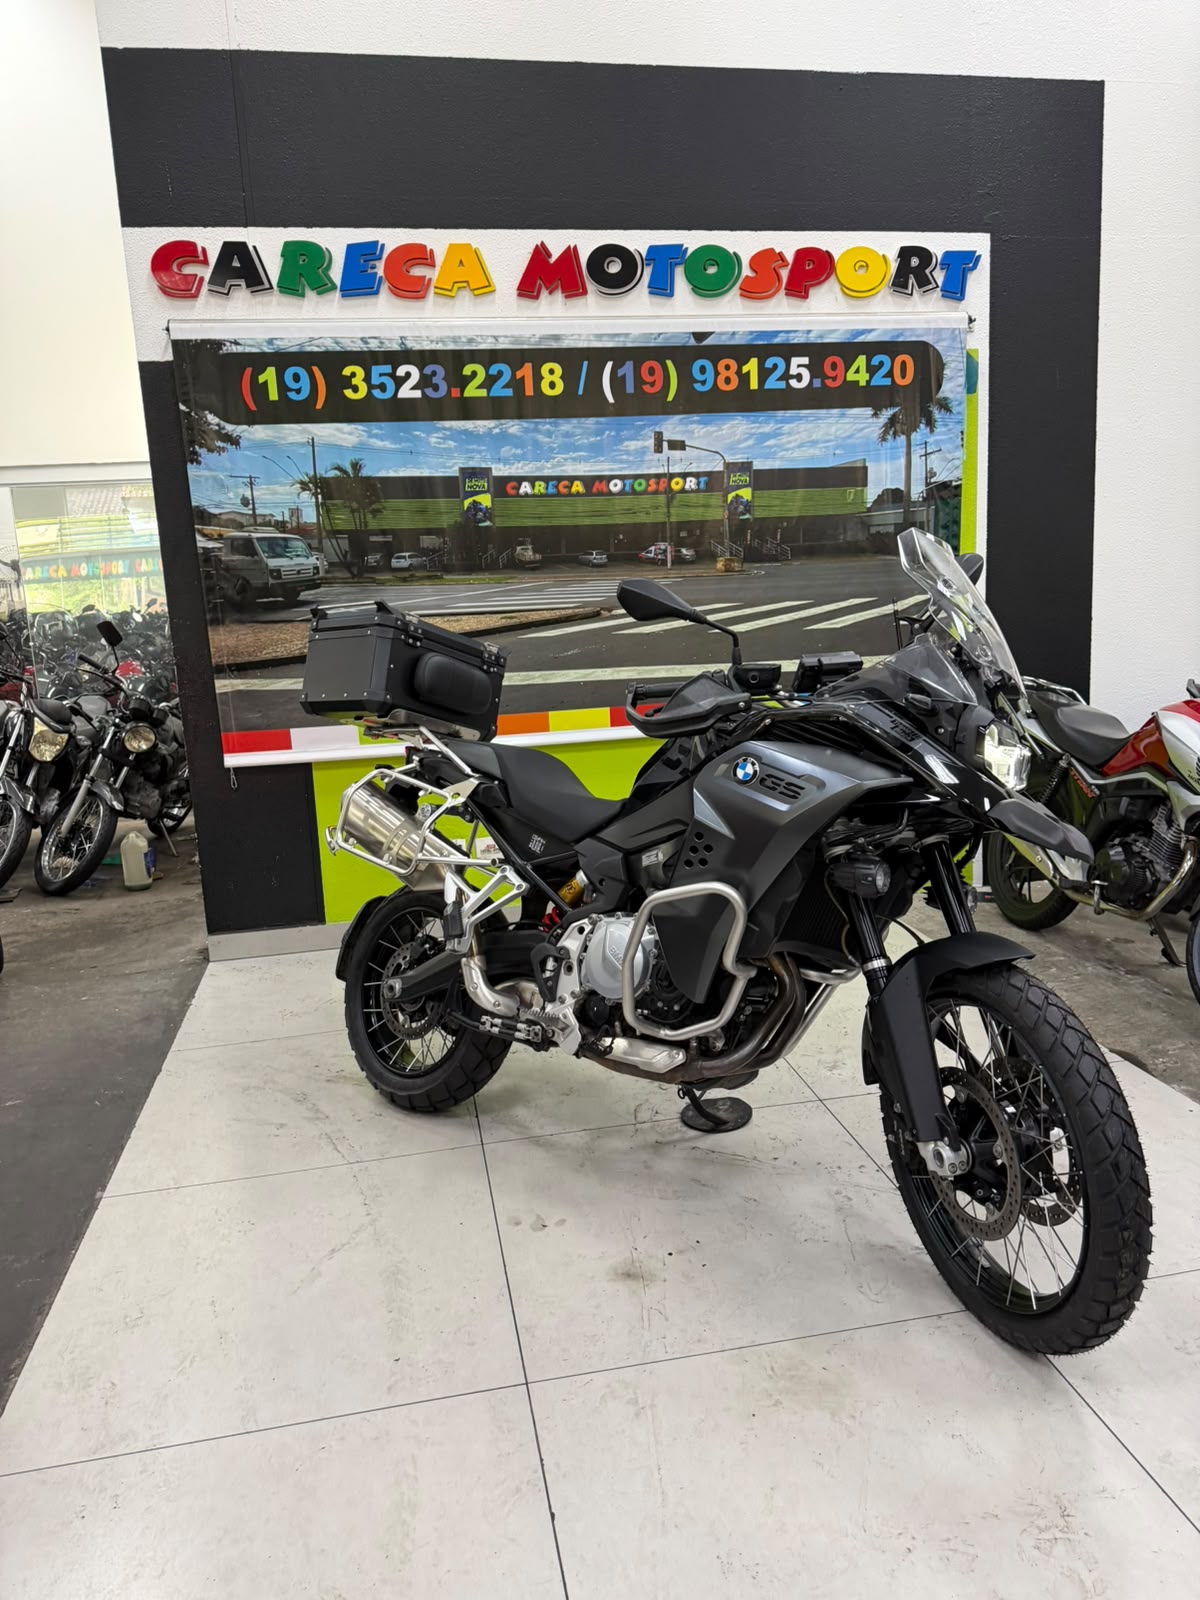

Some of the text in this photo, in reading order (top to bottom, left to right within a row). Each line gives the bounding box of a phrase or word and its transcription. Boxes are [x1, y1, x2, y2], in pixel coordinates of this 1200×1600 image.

[150, 239, 982, 301] CARECA MOTOSPORT
[240, 366, 327, 411] (19)
[341, 362, 564, 400] 3523.2218
[602, 359, 678, 403] (19)
[691, 354, 914, 393] 98125.9420
[505, 476, 709, 496] CARECA MOTOSPORT
[759, 773, 806, 800] GS
